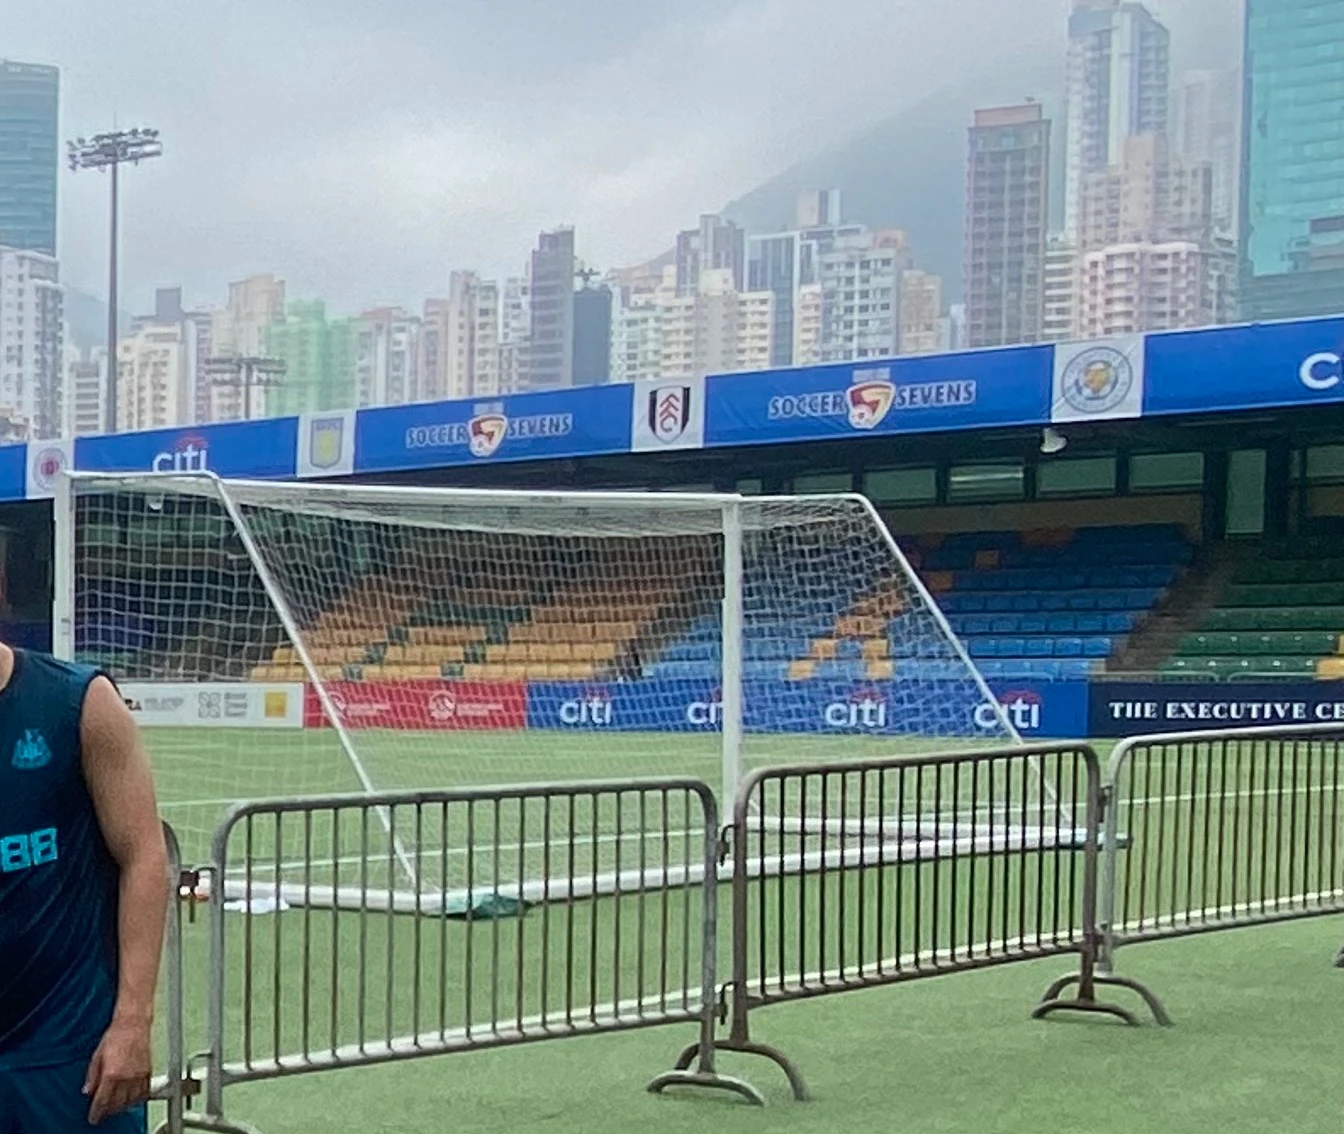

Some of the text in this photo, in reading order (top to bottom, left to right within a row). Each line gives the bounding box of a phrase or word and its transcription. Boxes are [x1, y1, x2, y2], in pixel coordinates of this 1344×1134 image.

[769, 382, 974, 417] SOCCER SEVENS
[407, 414, 570, 447] SOCCER SEVENS
[559, 697, 612, 724] citi
[825, 698, 887, 727] citi
[974, 698, 1040, 729] citi
[1109, 702, 1158, 719] THE
[1166, 702, 1306, 719] EXECUTIVE
